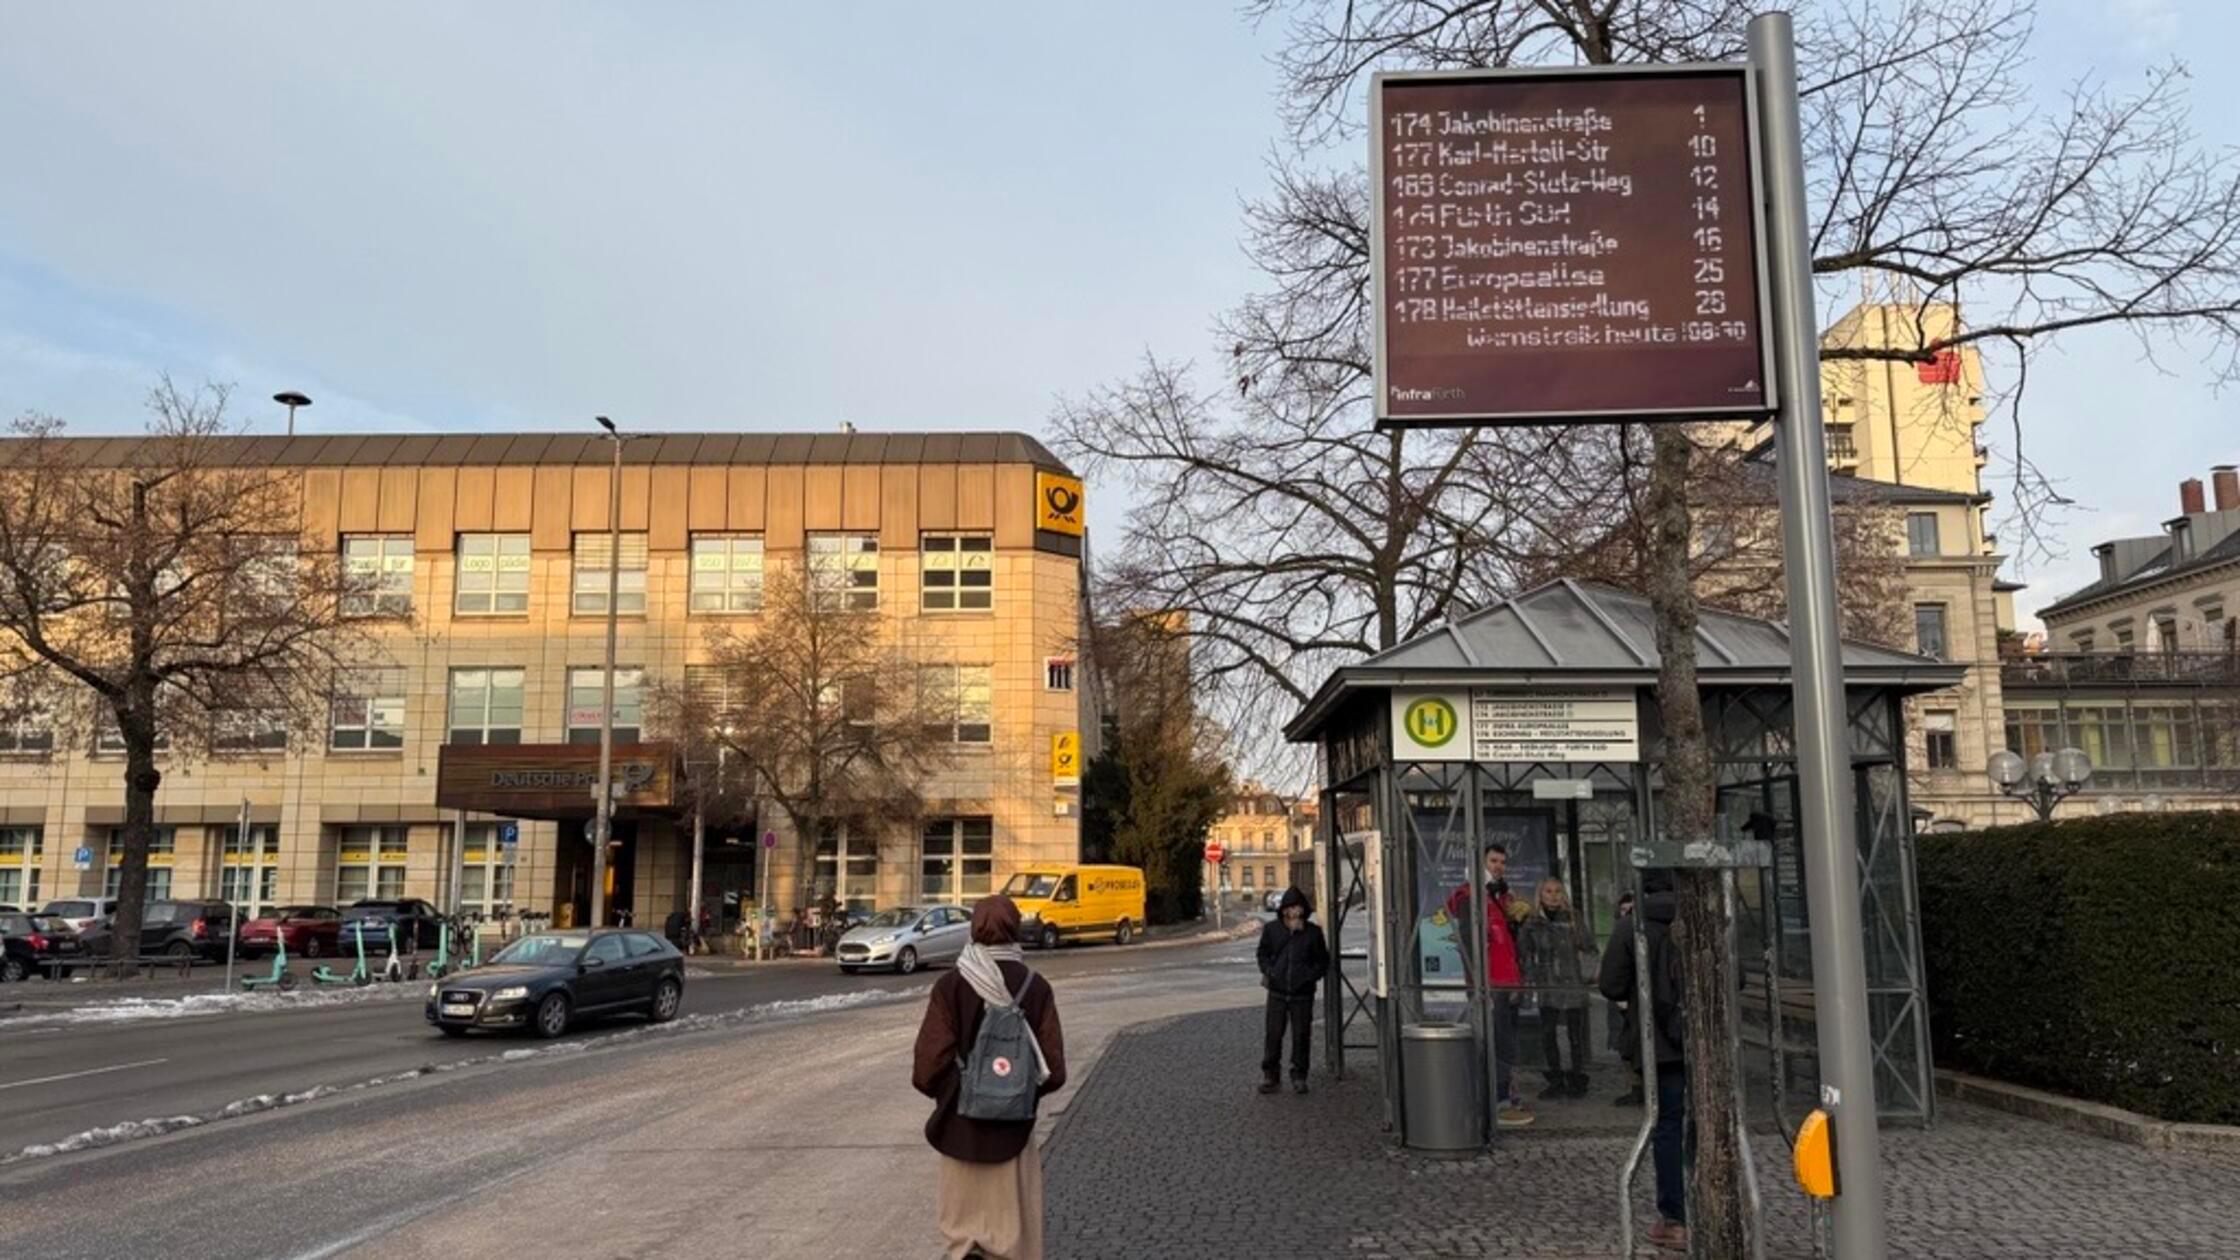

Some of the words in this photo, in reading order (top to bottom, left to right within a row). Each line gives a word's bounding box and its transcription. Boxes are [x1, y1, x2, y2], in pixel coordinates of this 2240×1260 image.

[1391, 112, 1432, 136] 174
[1693, 104, 1705, 129] 1
[1391, 142, 1433, 167] 177
[1688, 135, 1716, 157] 10
[1690, 165, 1718, 189] 12
[1692, 196, 1720, 220] 14
[1693, 227, 1723, 252] 16
[1394, 266, 1436, 292] 177
[1693, 258, 1724, 283] 25
[1395, 297, 1437, 322] 178
